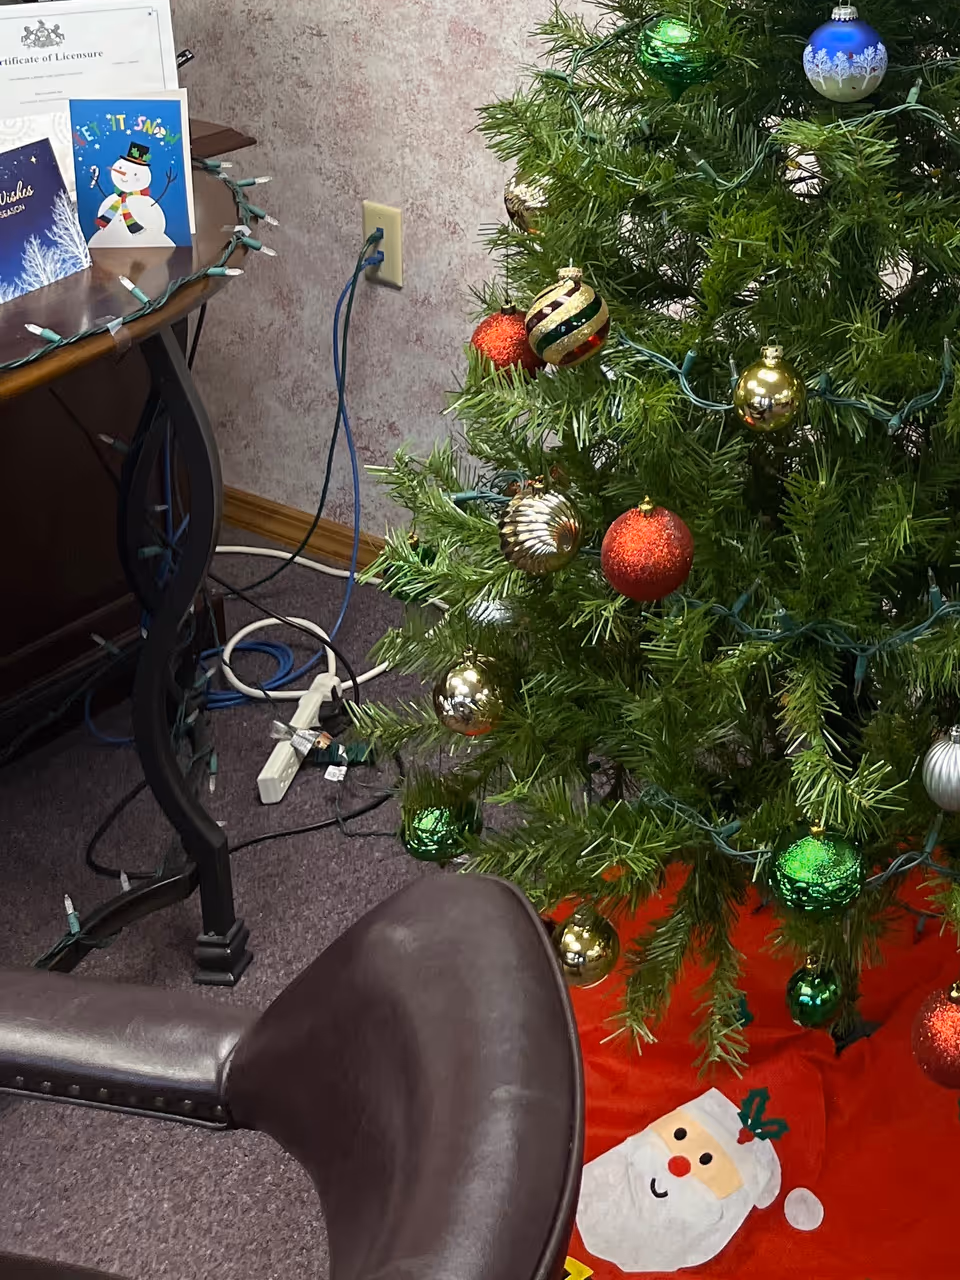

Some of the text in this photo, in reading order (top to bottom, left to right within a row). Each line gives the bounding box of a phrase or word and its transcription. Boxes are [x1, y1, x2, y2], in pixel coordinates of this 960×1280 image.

[0, 50, 103, 66] rtificate of Licensure
[73, 114, 182, 147] LET IT SNOW
